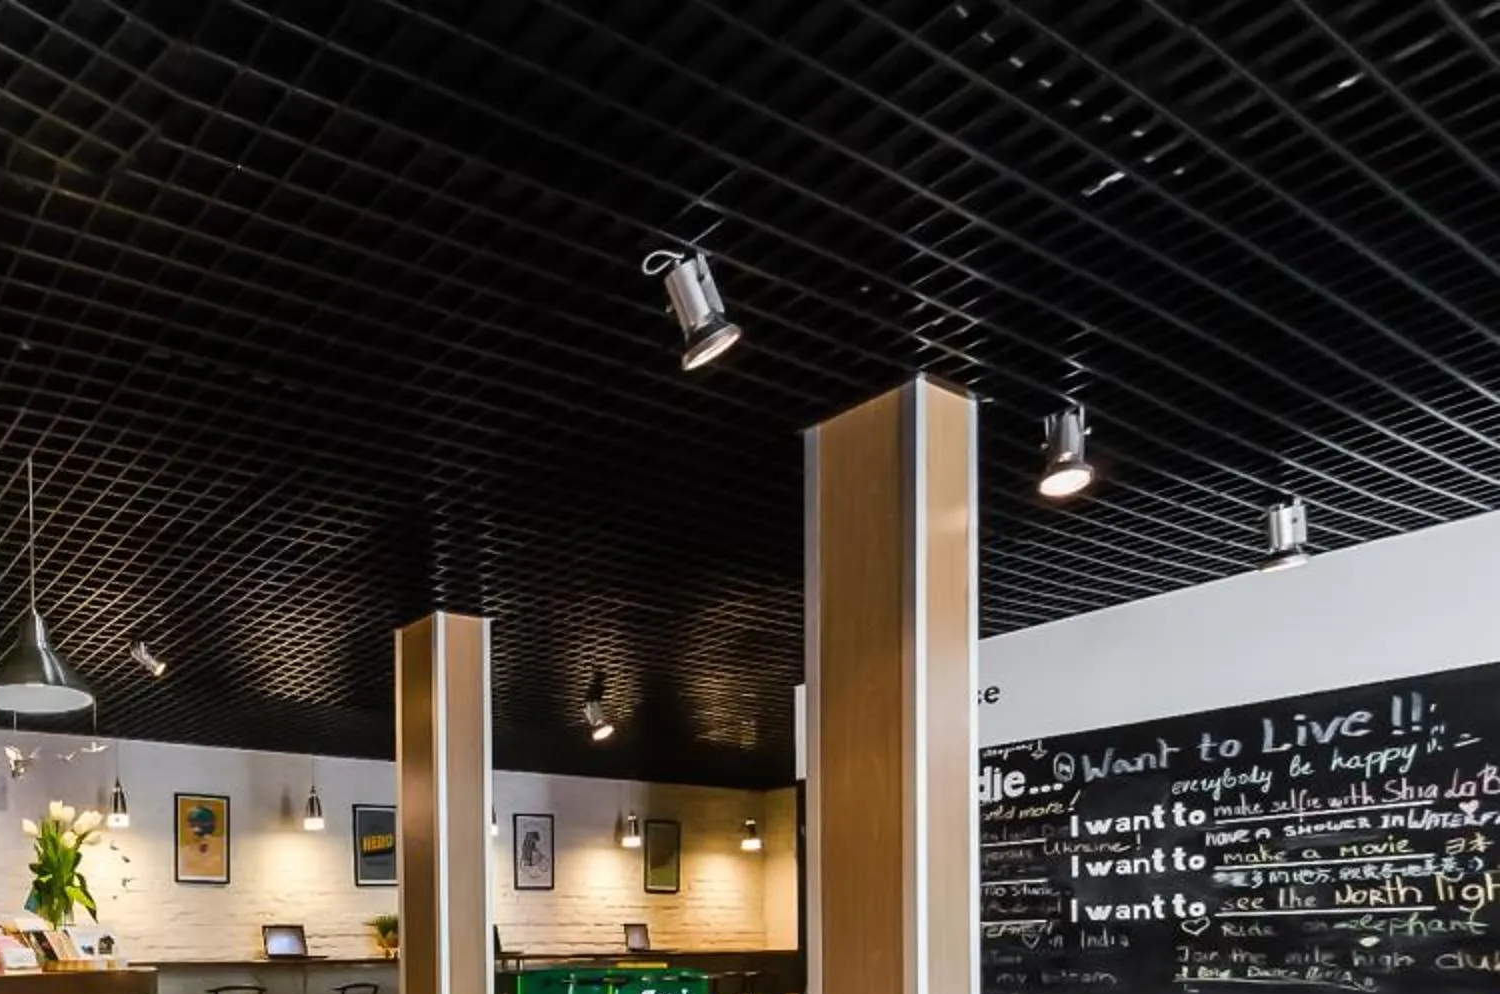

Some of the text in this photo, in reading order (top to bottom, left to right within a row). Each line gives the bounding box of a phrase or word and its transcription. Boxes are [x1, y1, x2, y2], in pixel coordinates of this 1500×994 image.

[1081, 737, 1180, 783] Want
[1197, 733, 1242, 761] to
[1262, 711, 1373, 753] Live
[1172, 744, 1417, 801] everybody be happy
[1070, 815, 1079, 837] I
[1085, 804, 1165, 836] want
[1172, 802, 1206, 826] to
[1213, 793, 1264, 816] make
[1071, 847, 1206, 878] I want to
[1301, 848, 1322, 860] a
[1070, 898, 1079, 923] I
[1085, 895, 1165, 921] want
[1172, 893, 1206, 917] to
